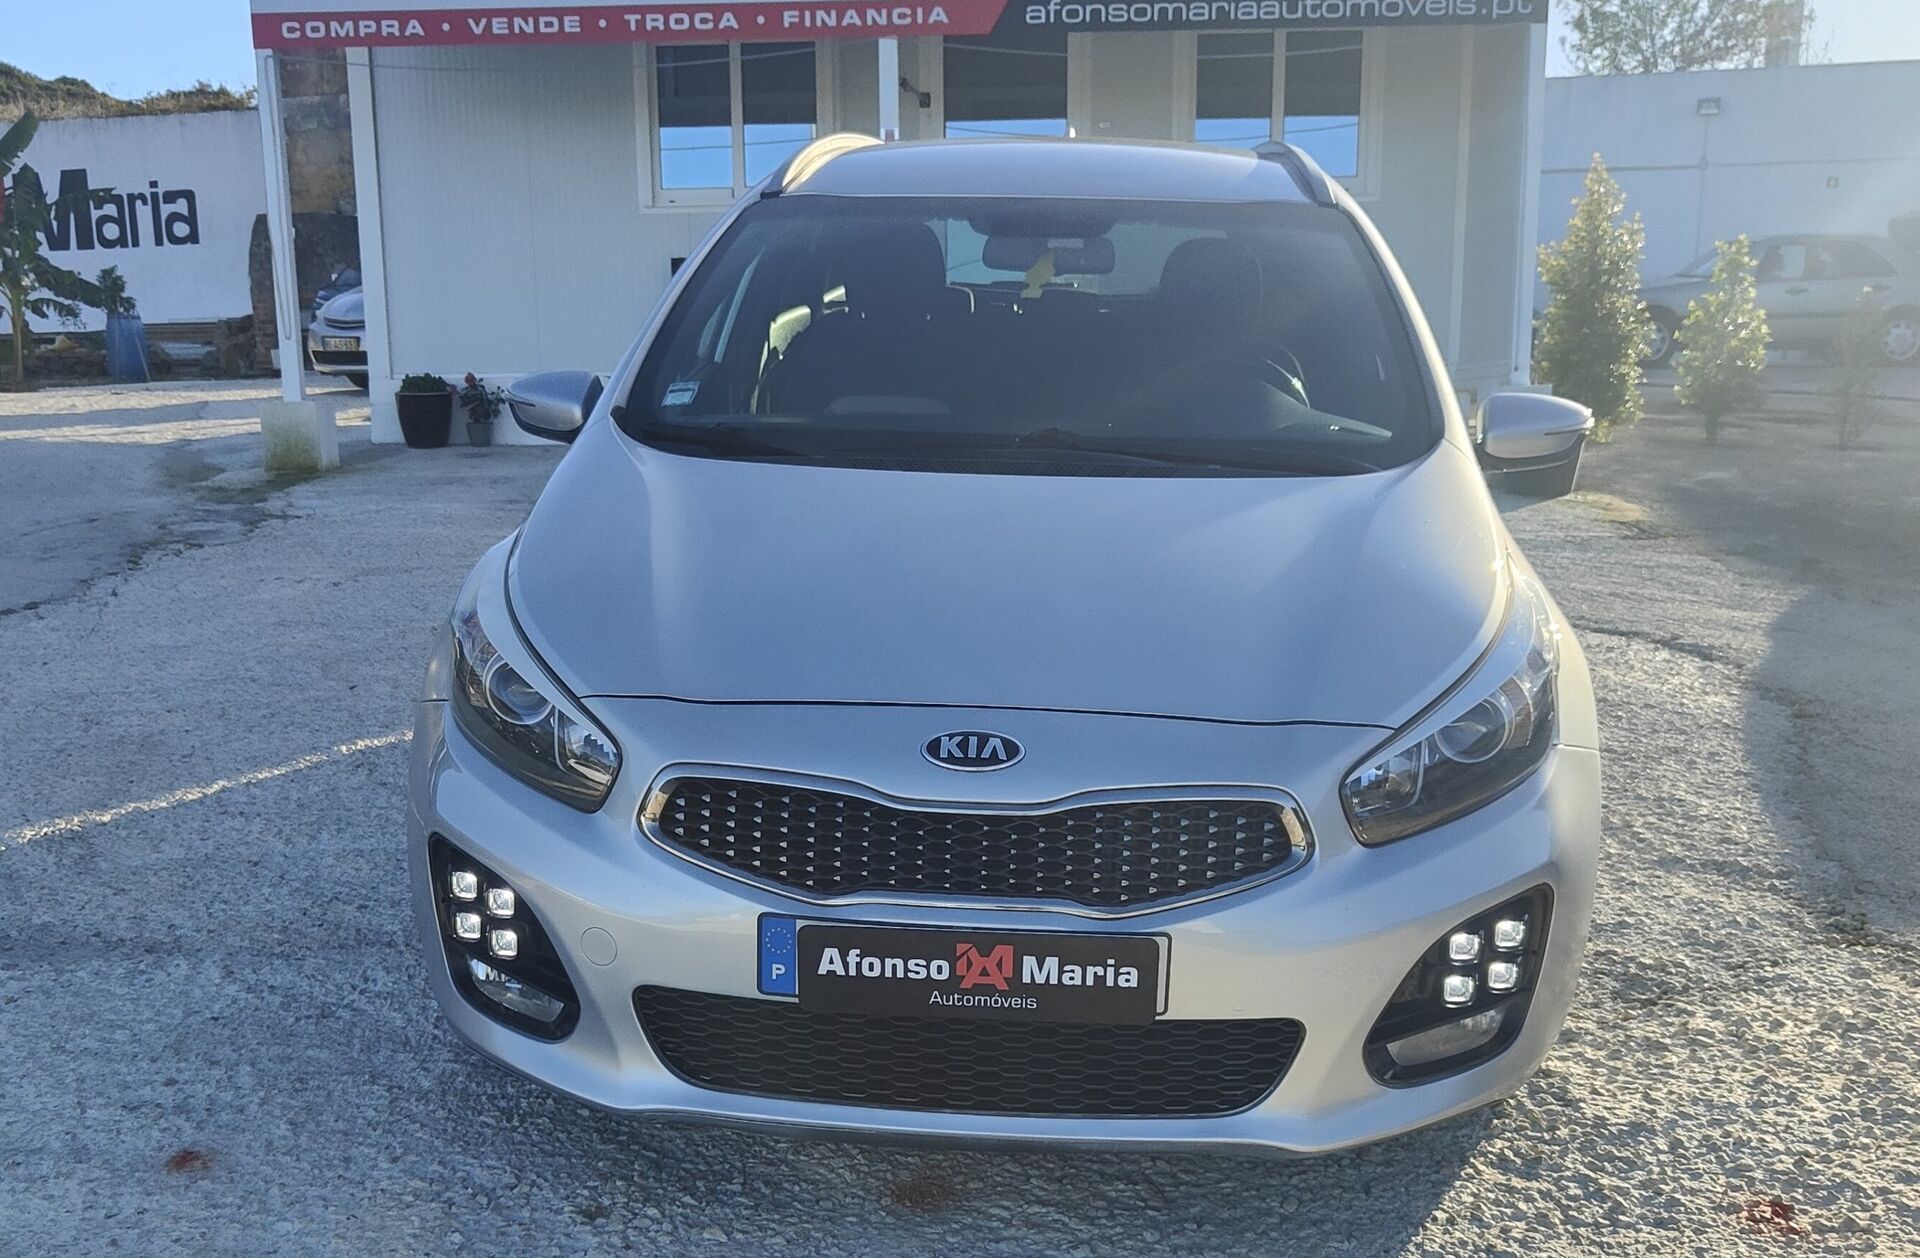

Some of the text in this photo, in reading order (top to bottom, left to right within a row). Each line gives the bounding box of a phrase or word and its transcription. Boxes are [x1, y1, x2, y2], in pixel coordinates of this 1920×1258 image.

[281, 6, 949, 39] COMPRA VENDE TROCA FINANCIA
[12, 168, 200, 251] Maria
[940, 735, 1007, 761] KIA
[772, 963, 786, 980] P
[817, 947, 950, 981] Afonso
[1022, 955, 1139, 988] Maria
[929, 990, 1038, 1009] Automóveis
